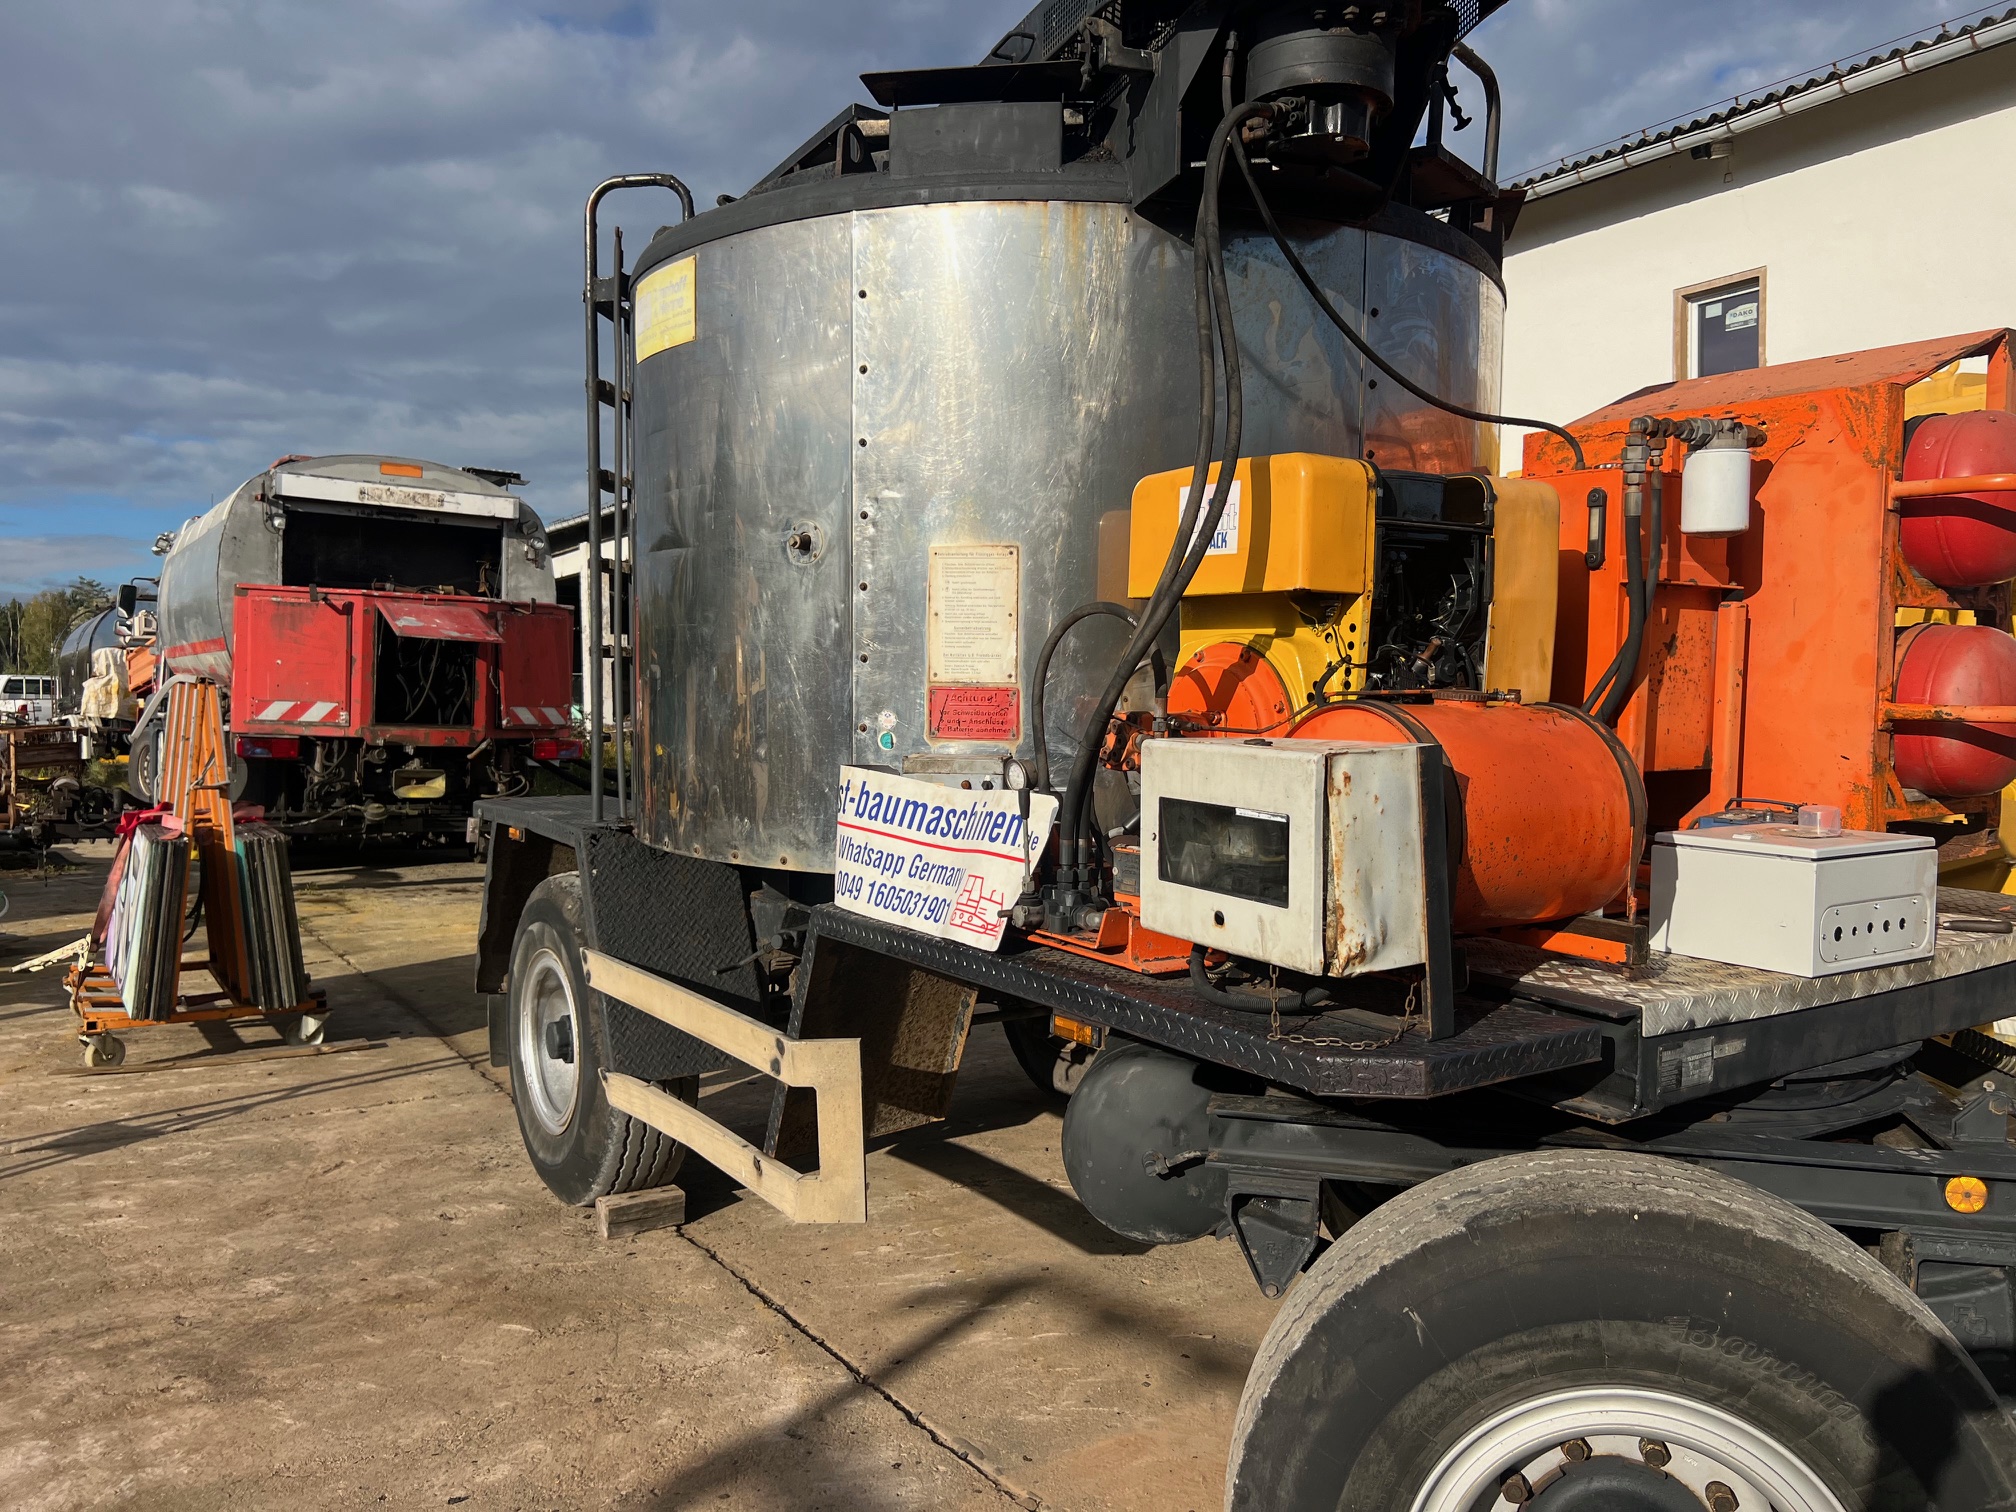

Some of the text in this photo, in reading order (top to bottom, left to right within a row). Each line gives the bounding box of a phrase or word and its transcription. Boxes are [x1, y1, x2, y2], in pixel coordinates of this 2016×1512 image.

[1209, 531, 1228, 549] ACK
[949, 692, 998, 704] Achtung!
[838, 833, 967, 894] Whatsapp Germany
[836, 870, 952, 925] 0049 1605031901
